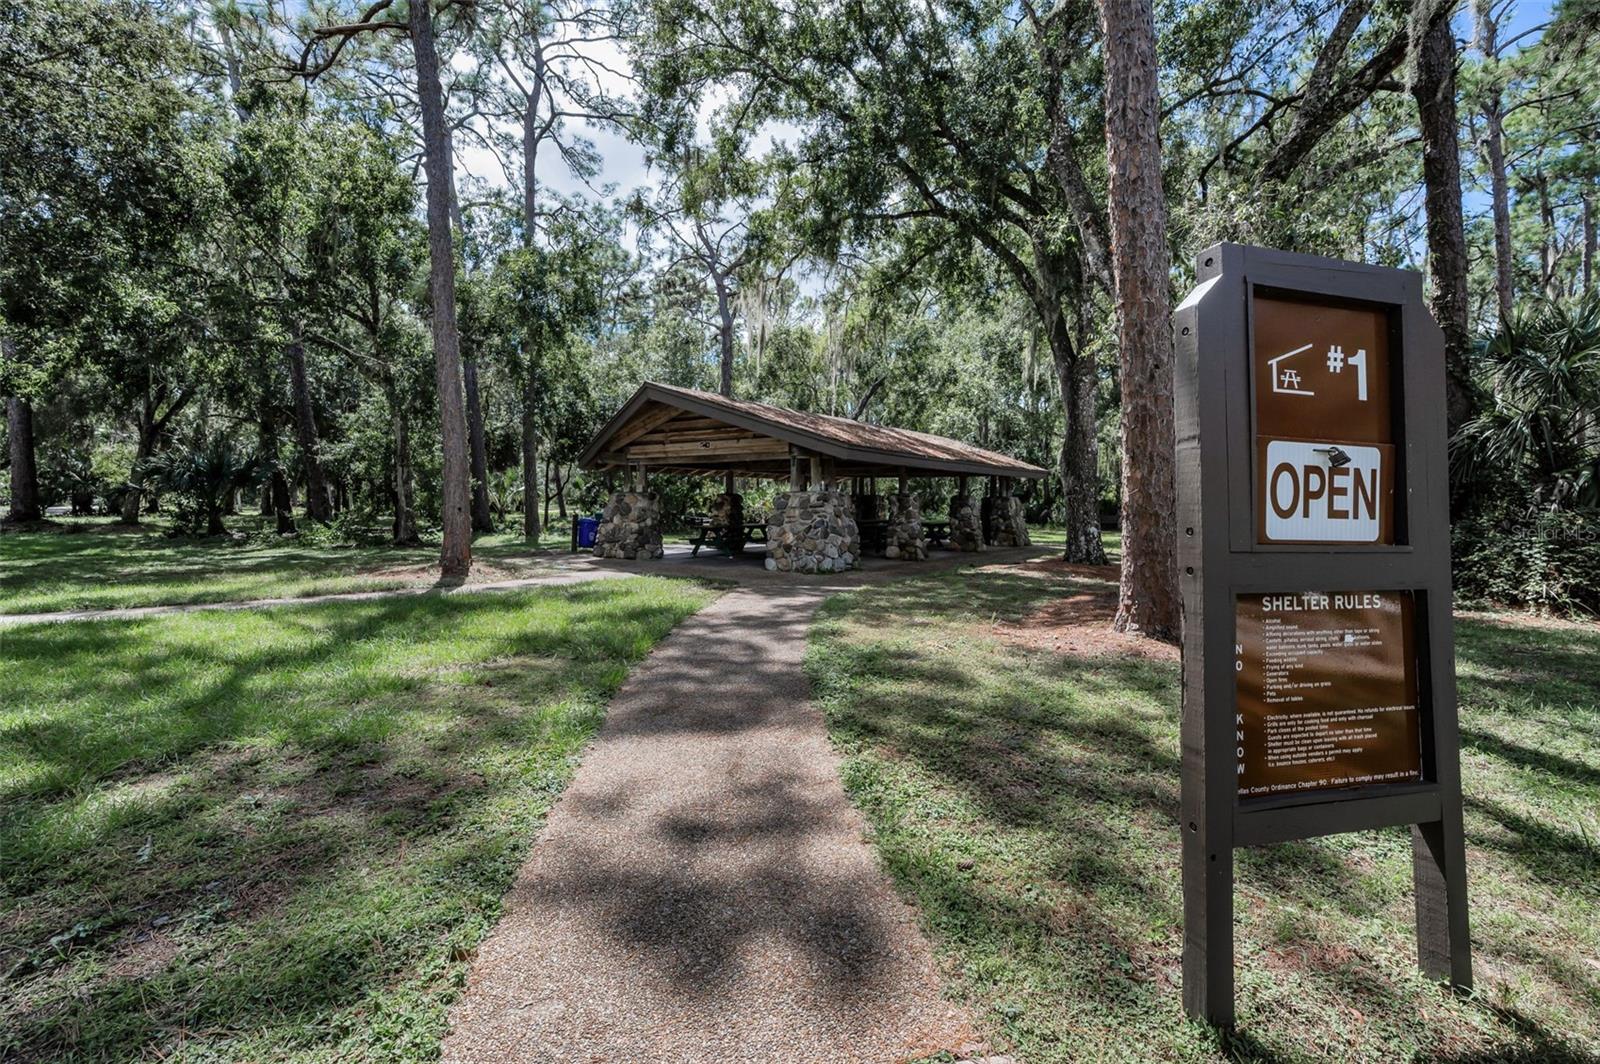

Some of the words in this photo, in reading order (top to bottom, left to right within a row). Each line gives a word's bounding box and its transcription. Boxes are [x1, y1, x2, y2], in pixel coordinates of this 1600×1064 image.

[1327, 345, 1367, 401] #1
[1270, 462, 1377, 520] OPEN
[1262, 596, 1329, 611] SHELTER
[1335, 594, 1381, 609] RULES
